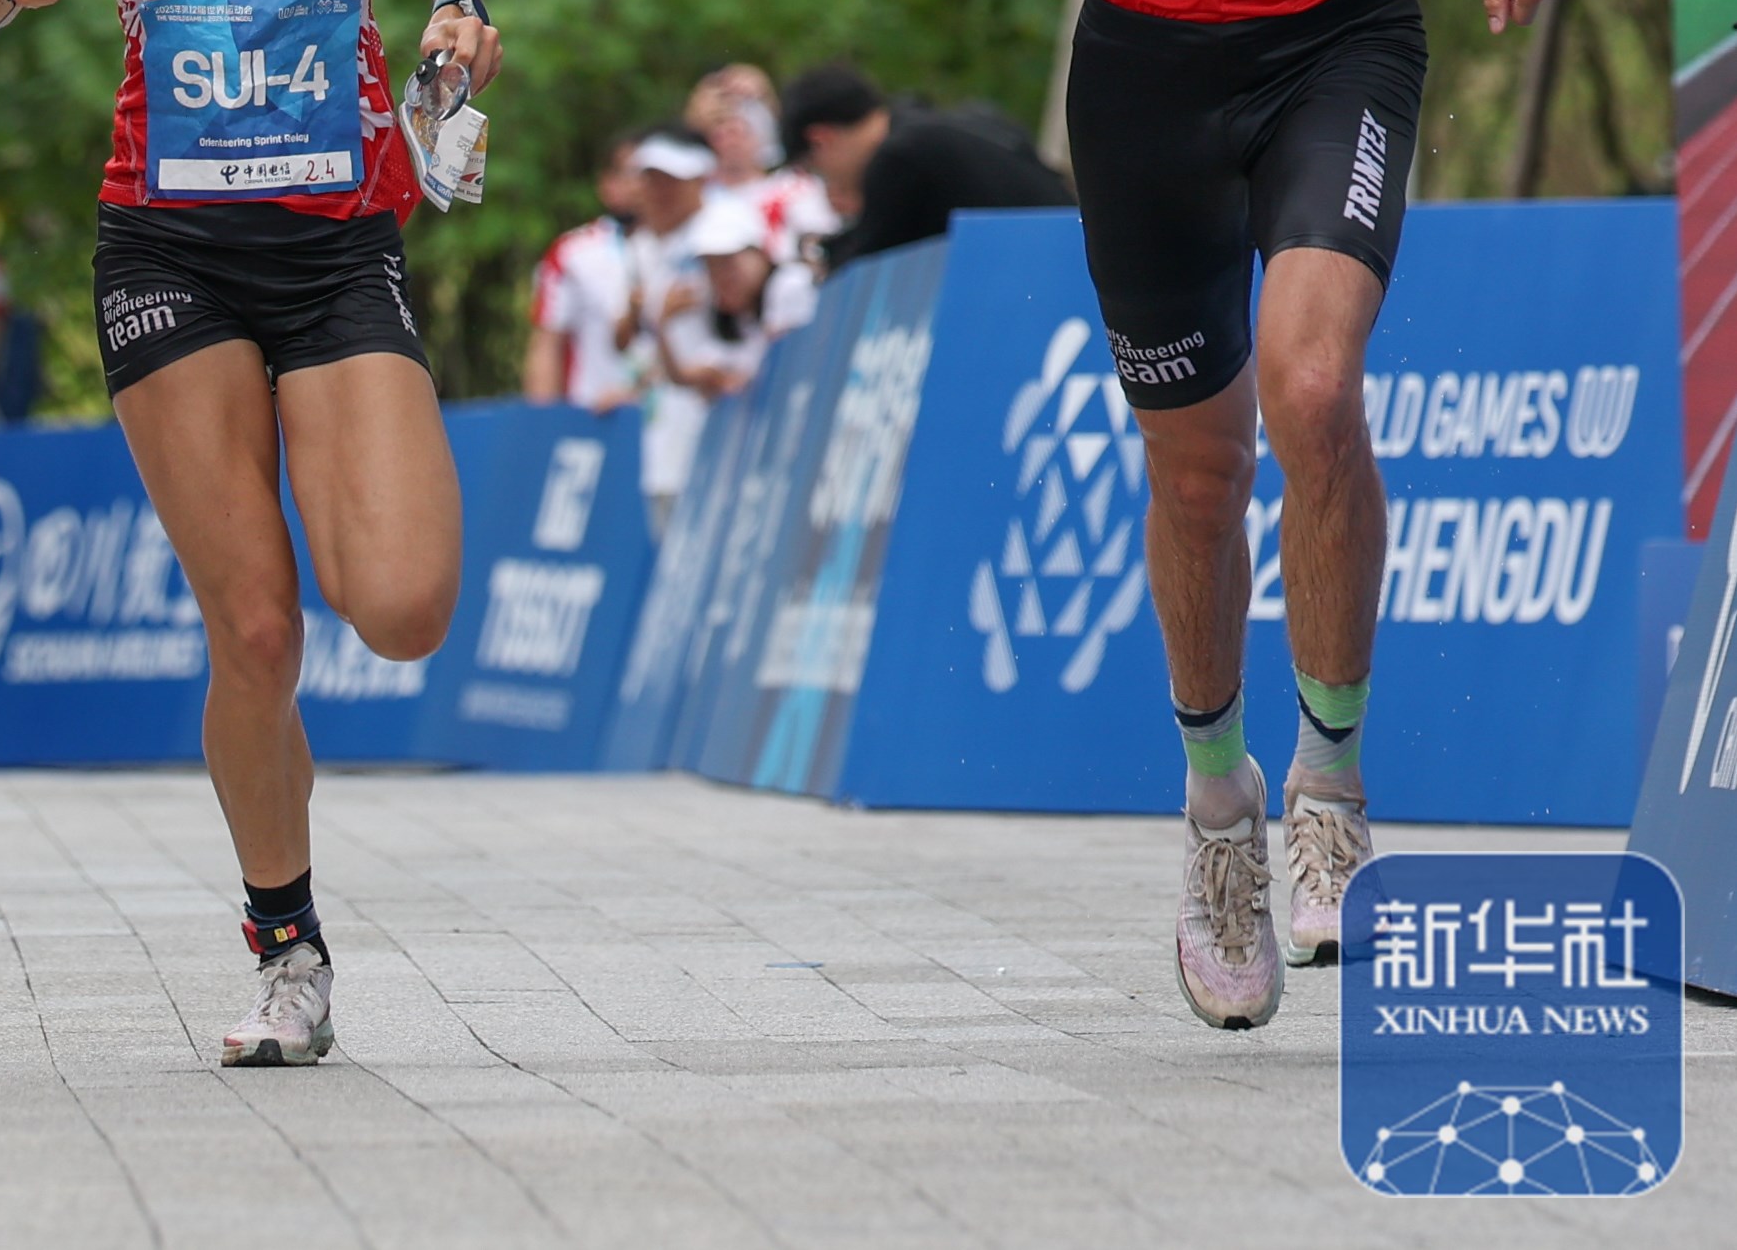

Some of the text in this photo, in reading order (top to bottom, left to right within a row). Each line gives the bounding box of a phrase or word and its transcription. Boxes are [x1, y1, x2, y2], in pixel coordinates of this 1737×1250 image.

[172, 44, 330, 109] SUI-4
[199, 133, 310, 148] Orienteering Sprint Relay
[243, 162, 291, 177] 中国电信
[305, 160, 335, 182] 2.4
[1343, 108, 1387, 231] TRIMTEX
[107, 304, 178, 352] team
[1116, 356, 1198, 384] eam
[1421, 370, 1568, 458] GAMES
[1379, 495, 1613, 626] HENGDU
